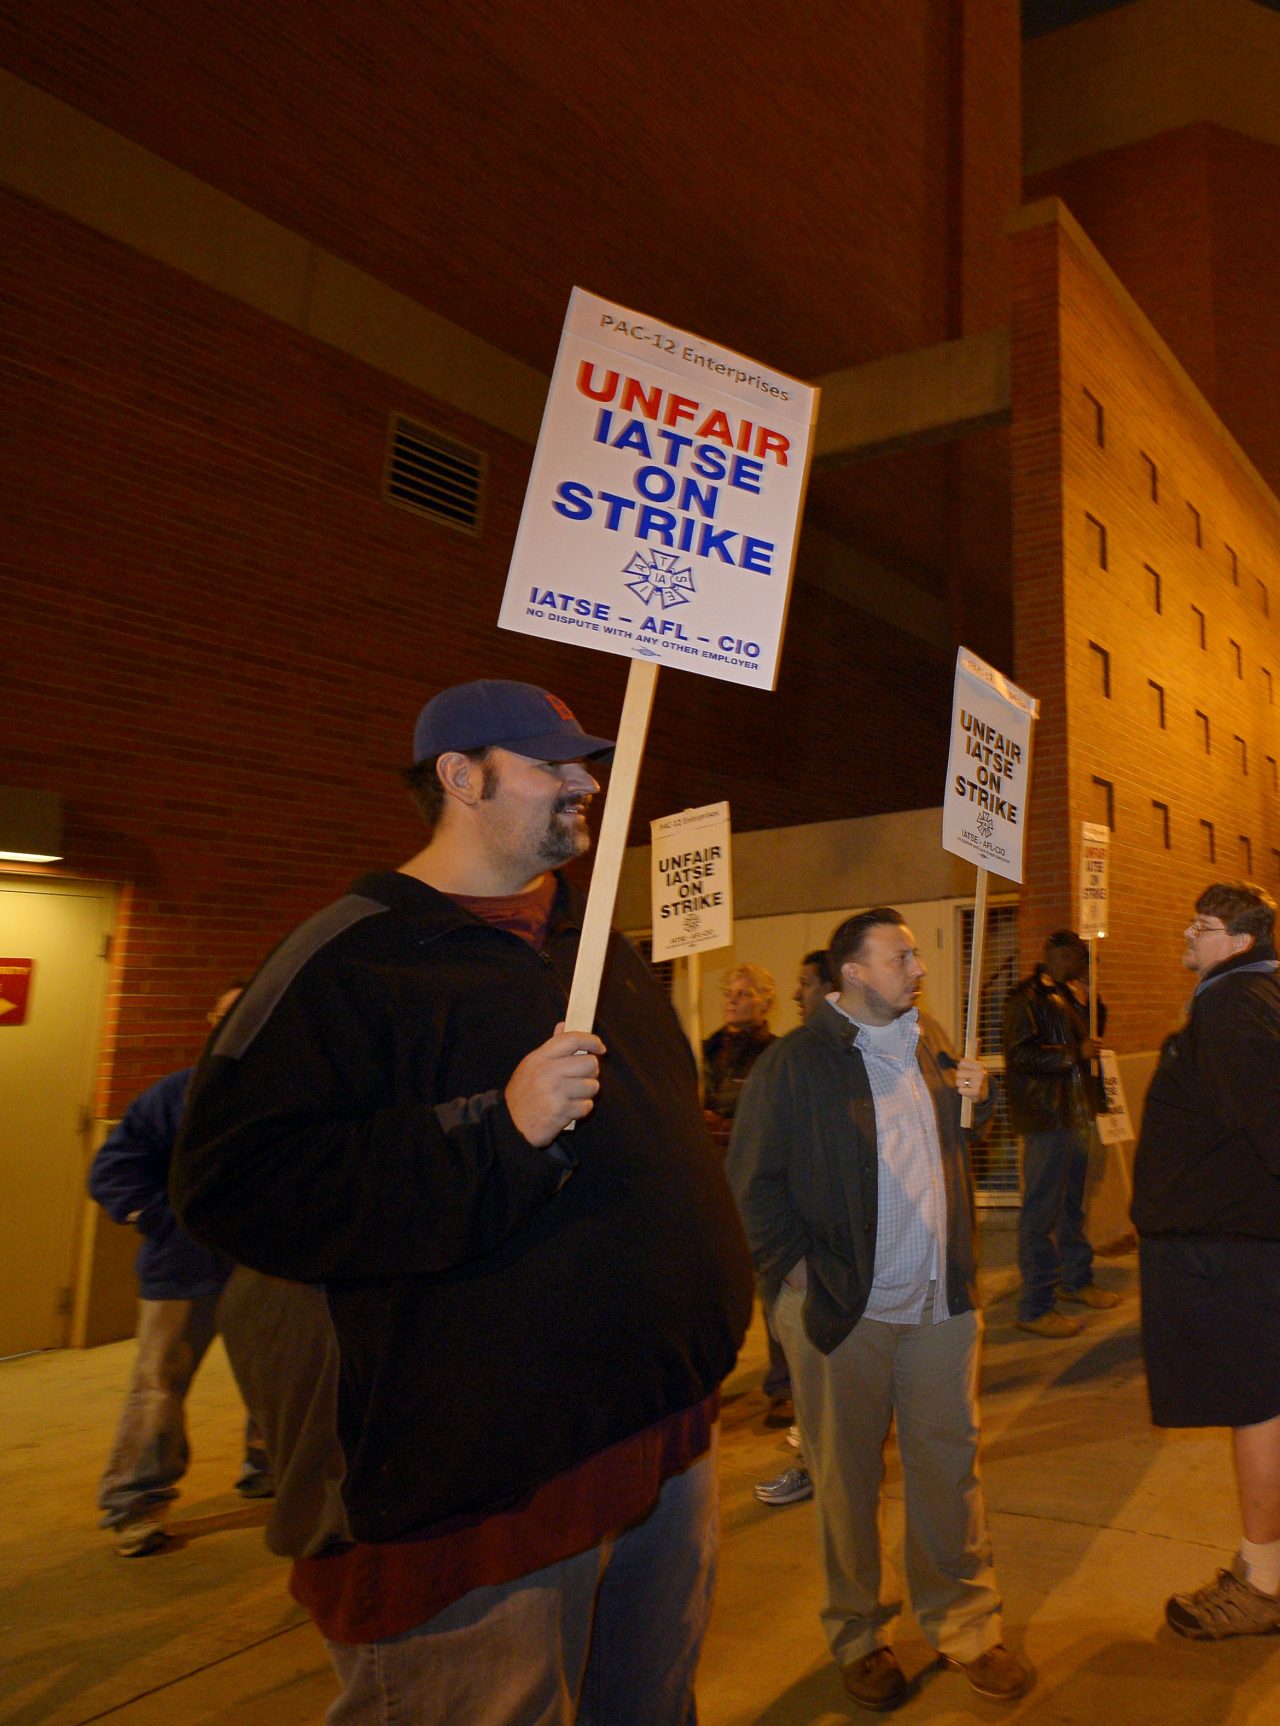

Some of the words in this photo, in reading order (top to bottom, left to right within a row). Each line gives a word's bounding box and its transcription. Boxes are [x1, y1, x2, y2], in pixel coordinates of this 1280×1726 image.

[600, 313, 676, 355] PAC-12
[681, 346, 790, 402] Enterprises
[575, 360, 791, 467] UNFAIR
[593, 408, 765, 495] IATSE
[633, 466, 719, 519] ON
[551, 481, 776, 576] STRIKE
[526, 607, 544, 618] NO
[547, 612, 600, 632] DISPUTE
[603, 625, 633, 639] WITH
[635, 634, 658, 645] ANY
[661, 640, 699, 656] OTHER
[701, 650, 759, 671] EMPLOYER
[529, 586, 610, 622] IATSE
[639, 616, 689, 641] AFL
[717, 635, 761, 658] CIO
[960, 708, 1022, 765] UNFAIR
[966, 735, 1013, 780] IATSE
[954, 775, 1017, 824] STRIKE
[976, 765, 1001, 794] ON
[659, 846, 722, 873] UNFAIR
[666, 863, 714, 887] IATSE
[660, 892, 724, 919] STRIKE
[679, 881, 703, 899] ON
